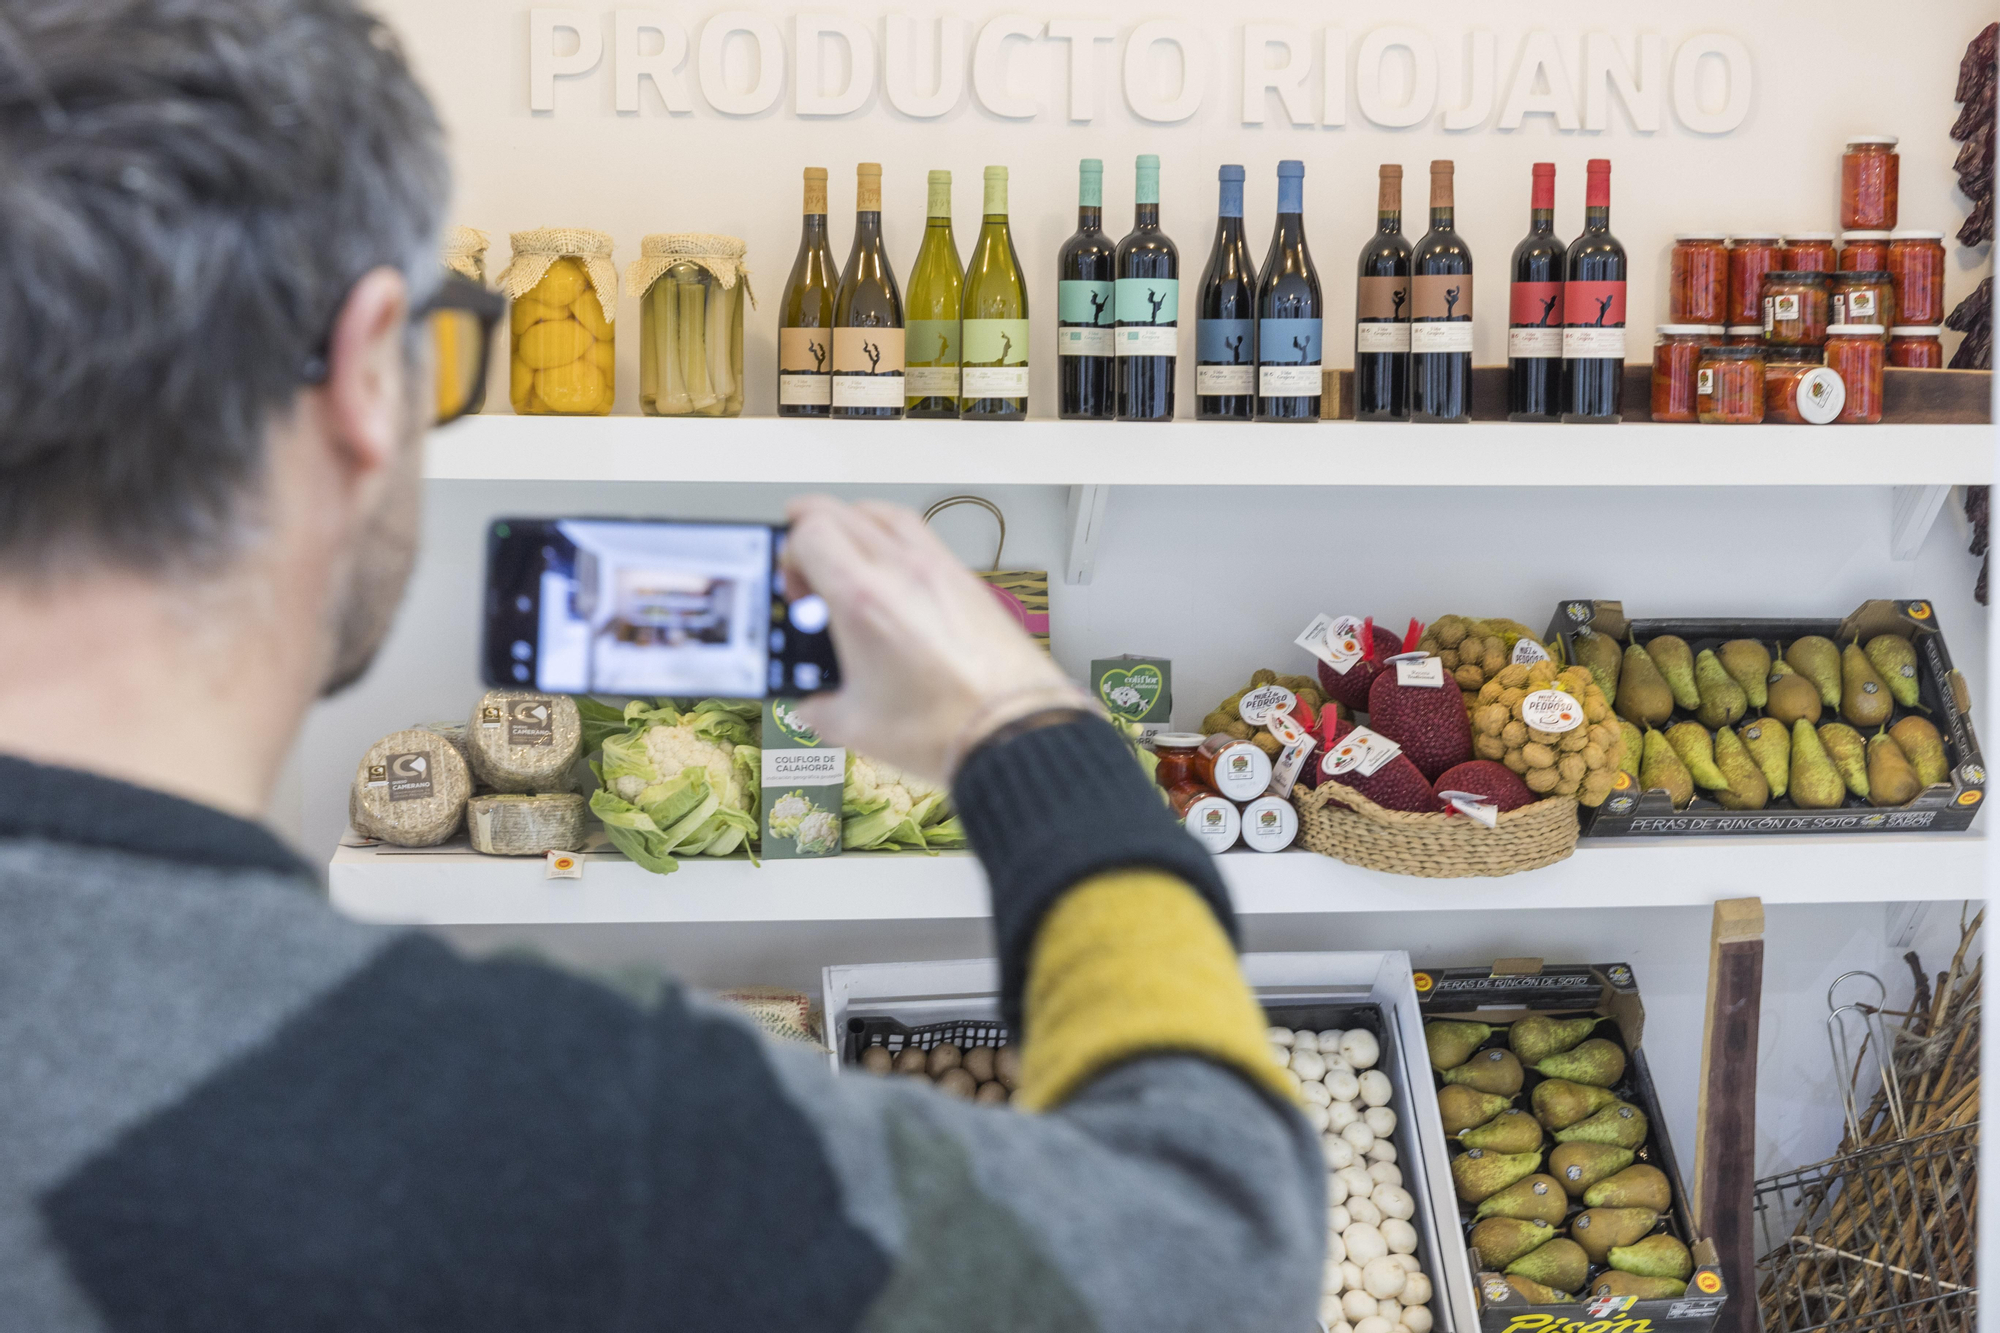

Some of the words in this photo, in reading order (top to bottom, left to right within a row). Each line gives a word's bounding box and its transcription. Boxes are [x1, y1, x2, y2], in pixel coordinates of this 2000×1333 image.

[529, 8, 1203, 124] PRODUCTO
[1239, 22, 1755, 134] RIOJANO
[1124, 675, 1159, 684] coliflor
[1253, 691, 1273, 700] NUEZ
[1245, 694, 1288, 709] PEDROSO
[1528, 701, 1573, 712] PEDROSO
[775, 756, 821, 764] COLIFLOR
[823, 755, 836, 763] DE
[776, 764, 835, 772] CALAHORRA
[392, 781, 431, 790] CAMERANO
[1630, 818, 1687, 831] PERAS
[1689, 818, 1715, 830] DE
[1716, 816, 1786, 831] RINCÓN
[1787, 817, 1809, 829] DE
[1811, 817, 1859, 829] SOTO
[1437, 979, 1476, 990] PERAS
[1477, 979, 1492, 989] DE
[1494, 977, 1539, 988] RINCÓN
[1540, 977, 1557, 987] DE
[1557, 977, 1588, 986] SOTO
